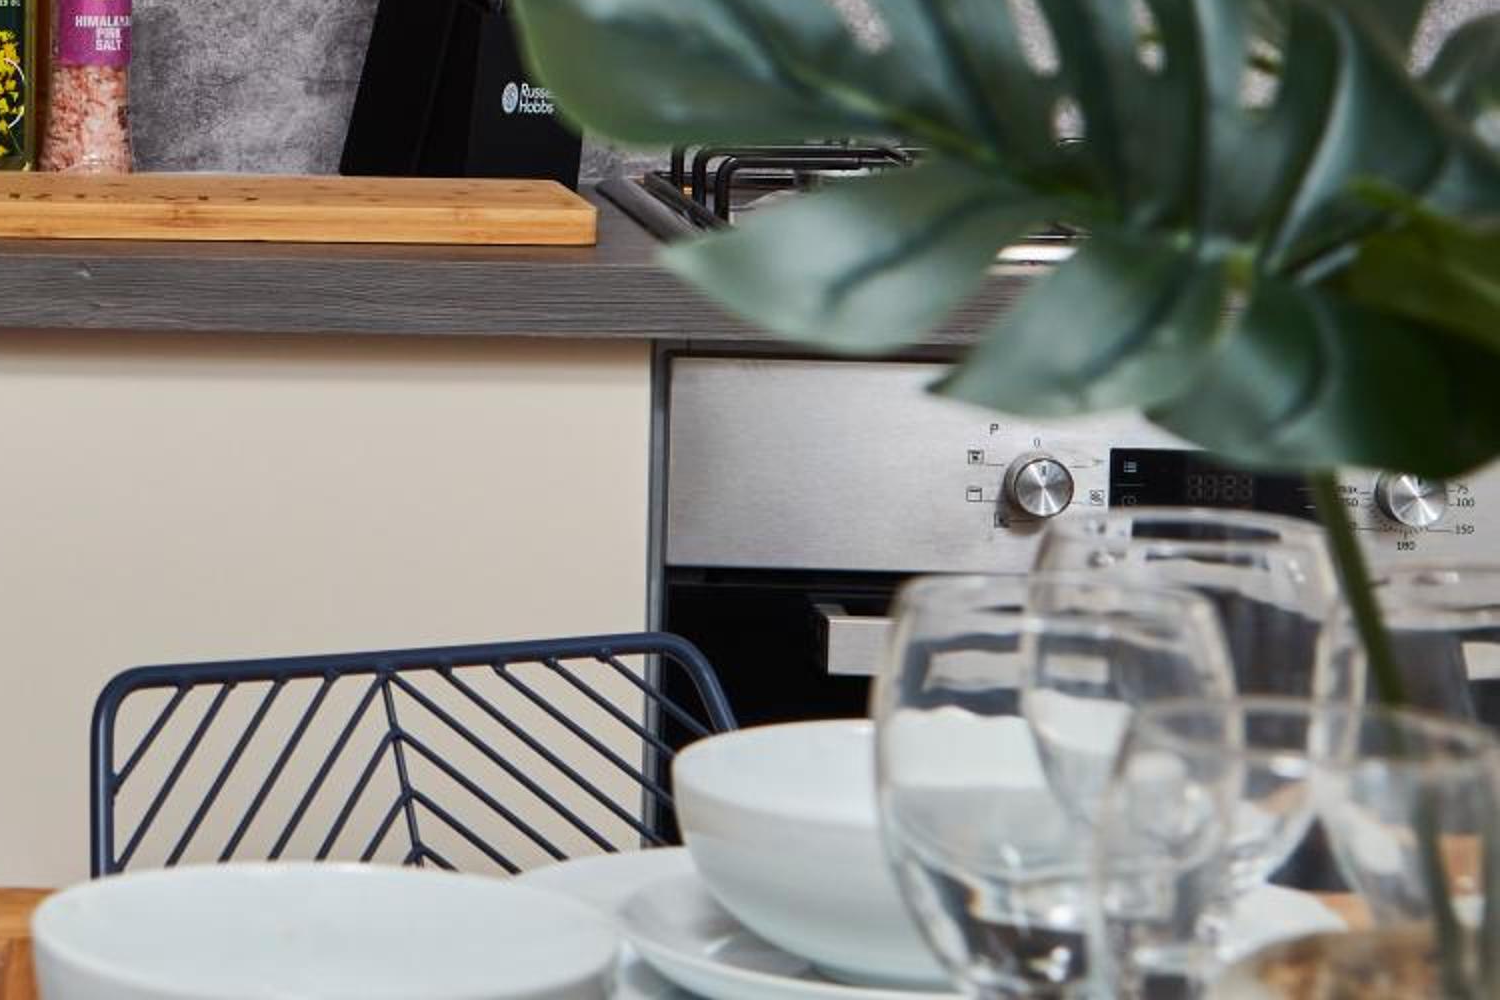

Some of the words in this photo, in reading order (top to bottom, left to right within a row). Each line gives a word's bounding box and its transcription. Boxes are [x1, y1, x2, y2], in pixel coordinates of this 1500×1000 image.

[95, 27, 121, 39] PINK
[95, 39, 122, 51] SALT
[520, 99, 554, 114] Hobbs
[989, 423, 1000, 435] P
[1457, 484, 1470, 495] 75
[1455, 497, 1475, 508] 100
[1455, 525, 1475, 536] 150
